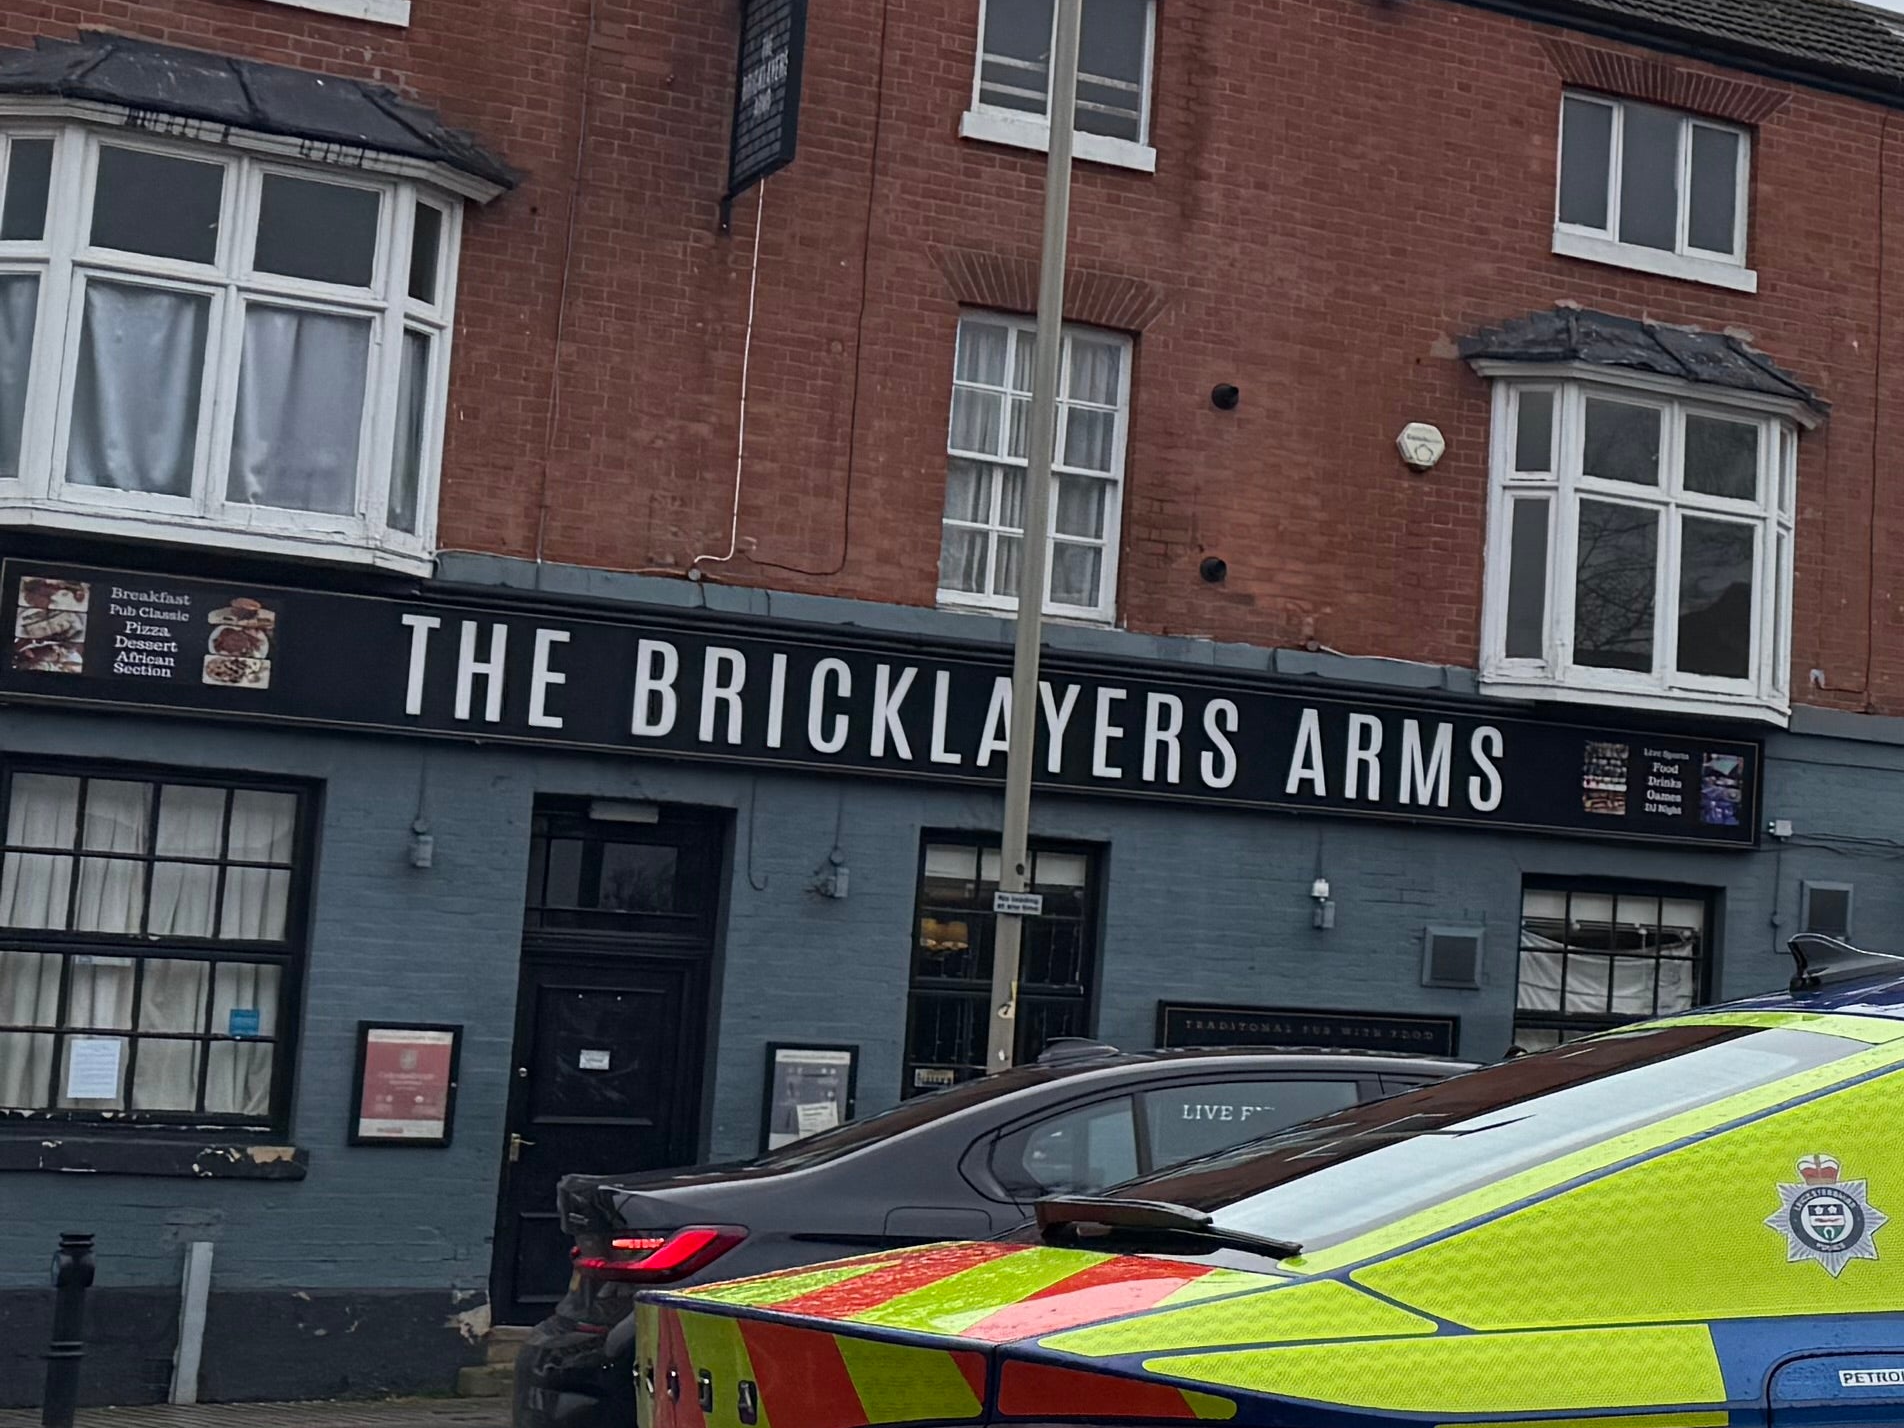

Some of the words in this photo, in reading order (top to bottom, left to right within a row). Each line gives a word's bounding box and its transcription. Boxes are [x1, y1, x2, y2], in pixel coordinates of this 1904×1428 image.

[111, 587, 191, 606] Breakfast
[110, 604, 136, 618] Pub
[139, 607, 189, 622] Classic
[125, 621, 171, 637] Pizza
[115, 635, 178, 653] Dessert
[116, 650, 175, 667] African
[113, 662, 171, 678] Section
[400, 613, 572, 729] THE
[631, 639, 1239, 789] BRICKLAYERS
[1285, 708, 1505, 813] ARMS
[1652, 762, 1679, 774] Food
[1648, 776, 1682, 788] Drinks
[1342, 1026, 1382, 1038] WITH
[1183, 1104, 1233, 1120] LIVE
